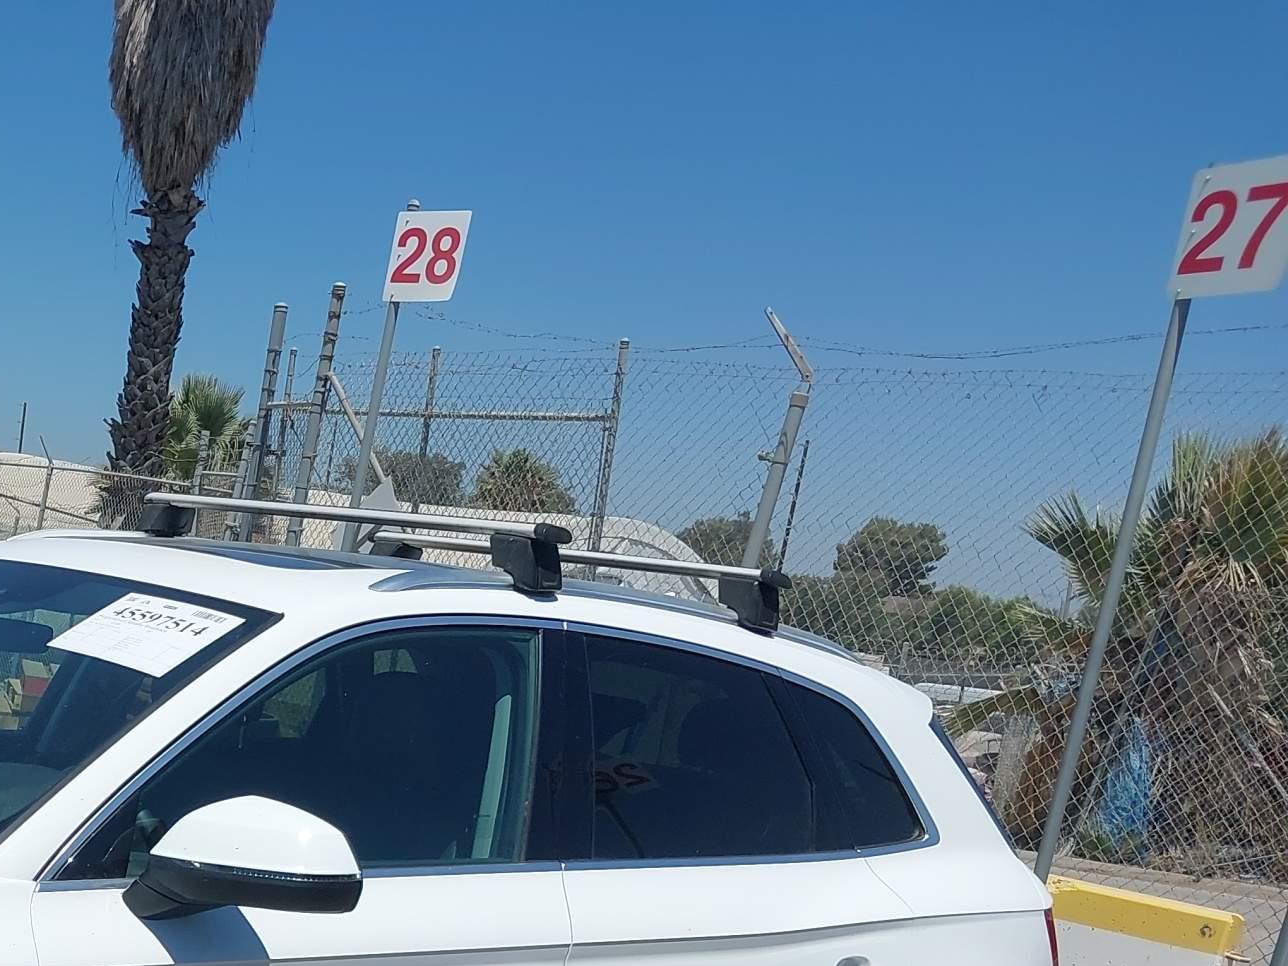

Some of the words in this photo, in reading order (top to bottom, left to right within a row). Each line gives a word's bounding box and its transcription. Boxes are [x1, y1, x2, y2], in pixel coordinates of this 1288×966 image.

[389, 226, 461, 285] 28
[1176, 181, 1288, 275] 27
[113, 606, 209, 637] 45597514
